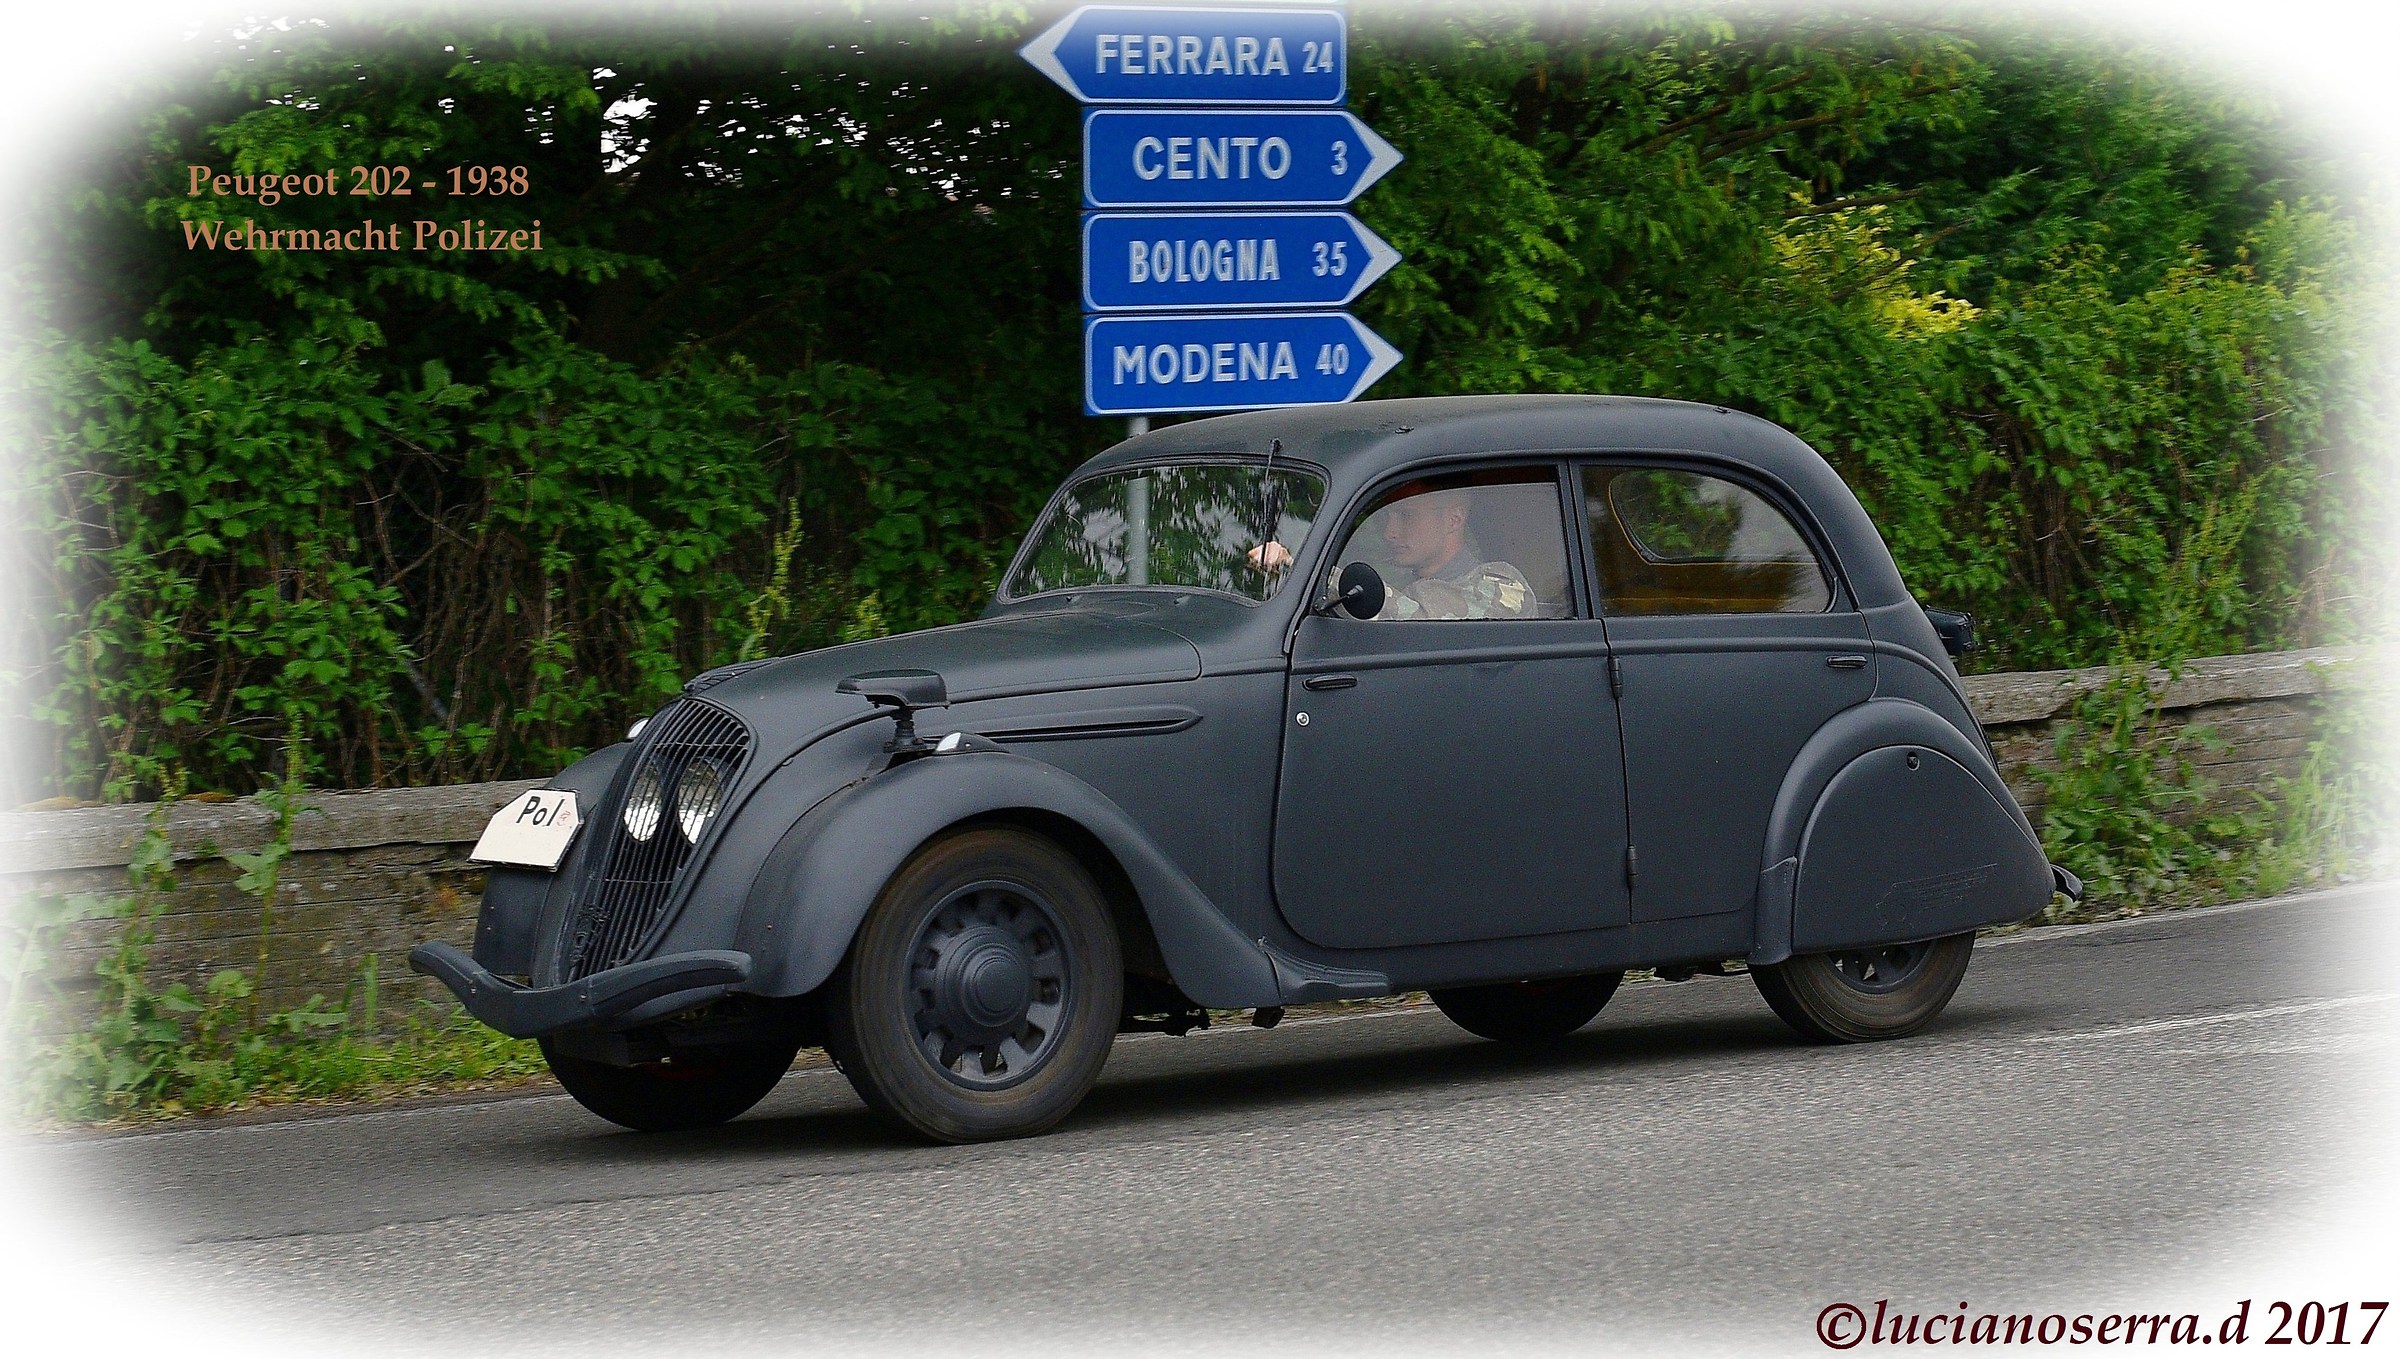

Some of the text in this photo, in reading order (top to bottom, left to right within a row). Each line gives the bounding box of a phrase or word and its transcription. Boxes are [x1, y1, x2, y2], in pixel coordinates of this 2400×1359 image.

[1095, 33, 1334, 76] FERRARA 24
[1132, 136, 1349, 181] CENTO 3
[1128, 238, 1348, 283] BOLOGNA 35
[1112, 341, 1350, 385] MODENA 40
[516, 795, 566, 827] Pol
